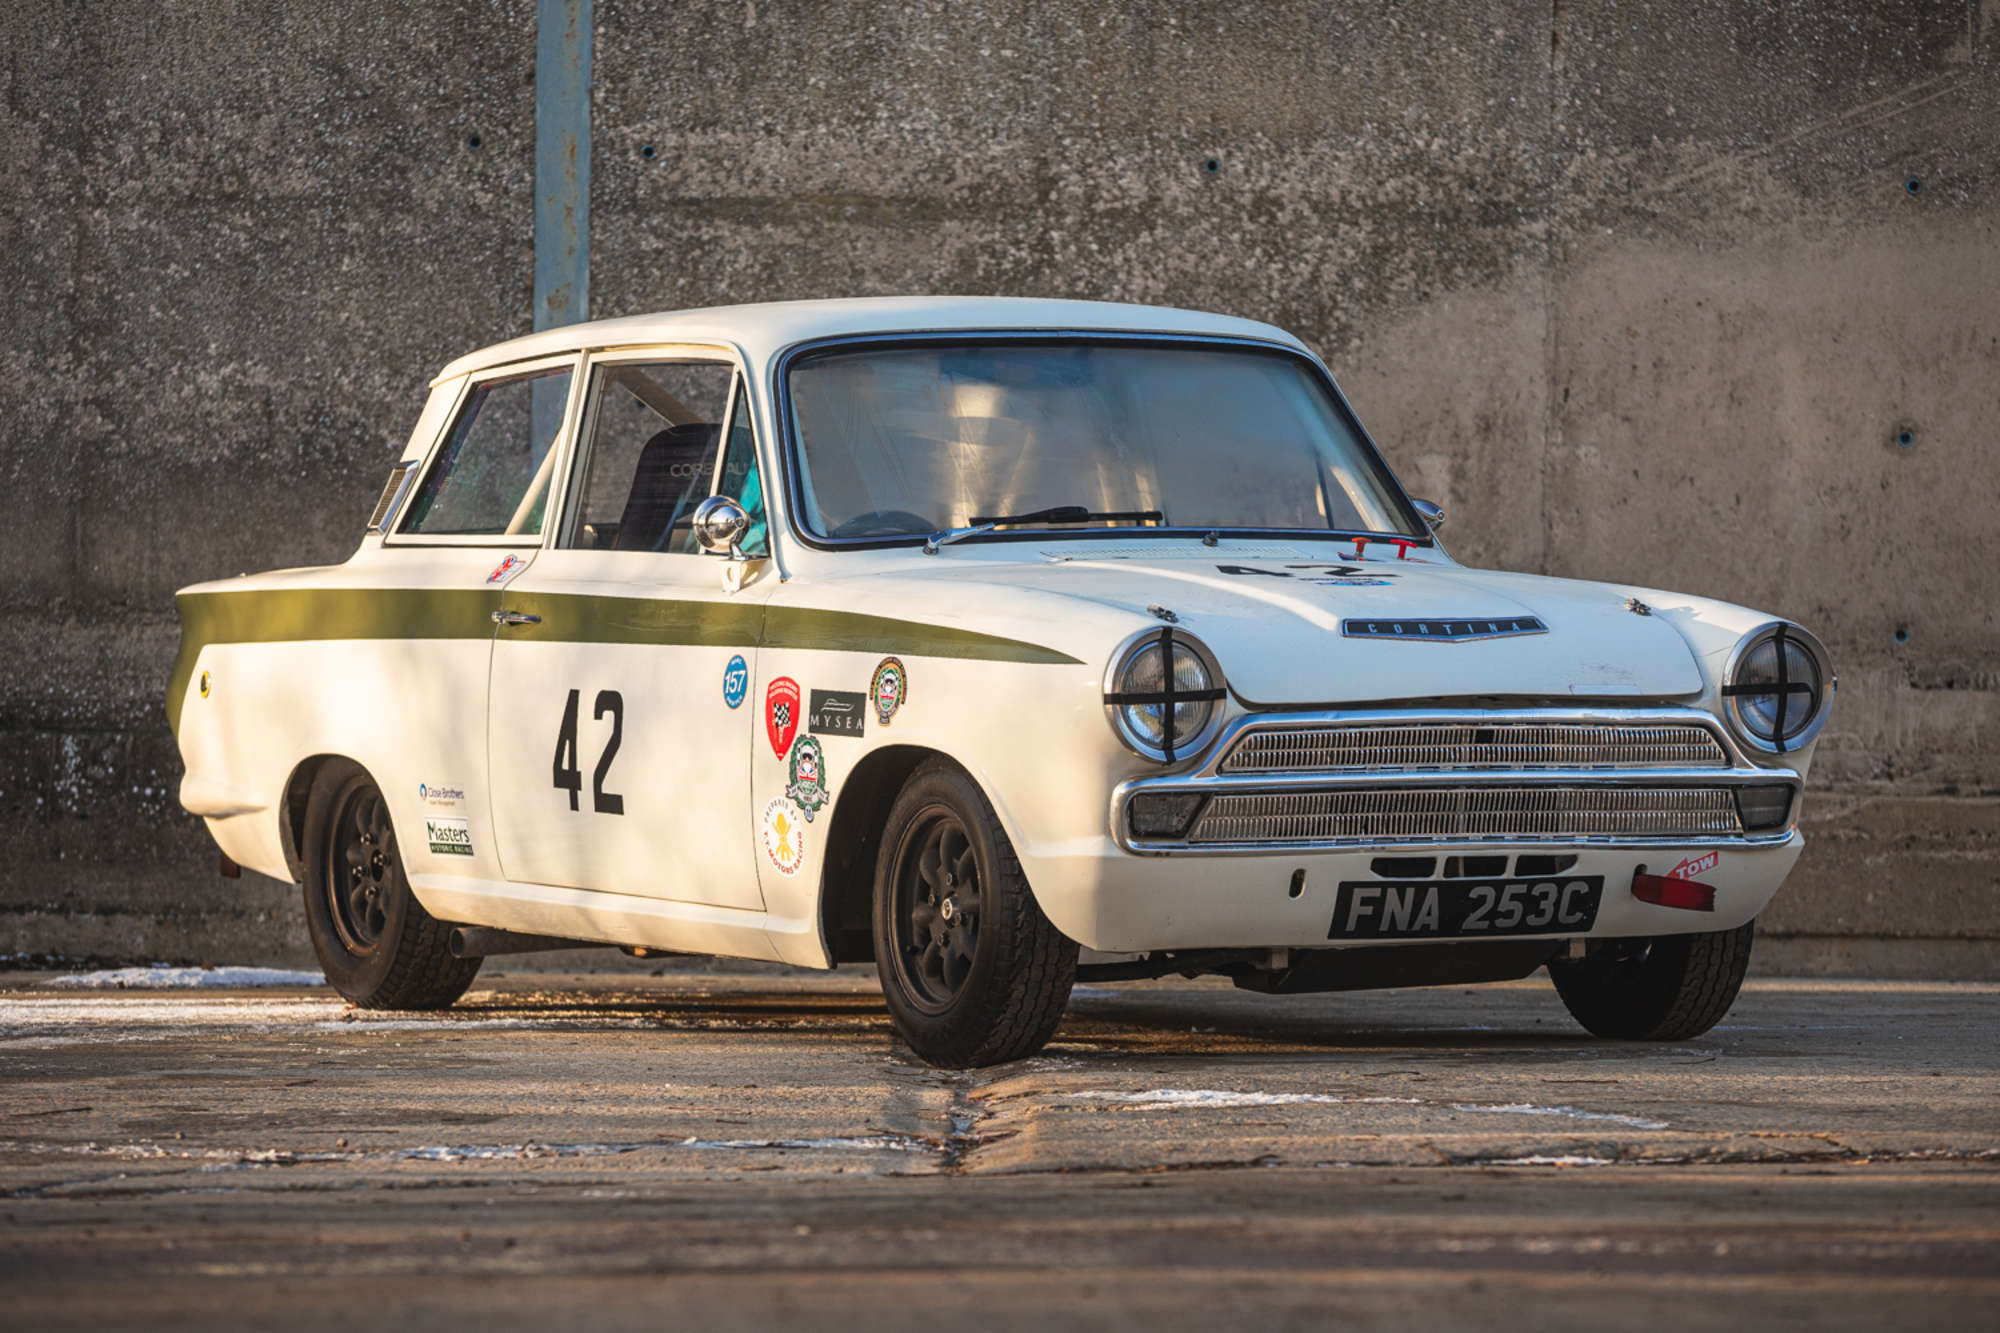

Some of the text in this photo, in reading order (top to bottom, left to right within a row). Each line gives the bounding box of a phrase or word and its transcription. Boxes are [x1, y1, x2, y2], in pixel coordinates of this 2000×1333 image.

[1215, 564, 1402, 578] 42
[1368, 622, 1520, 634] CORTINA
[725, 670, 746, 694] 157
[810, 713, 864, 730] MYSEA
[553, 689, 624, 815] 42
[427, 821, 470, 843] Masters
[1675, 855, 1715, 880] TOW
[1346, 880, 1590, 932] FNA 253C
